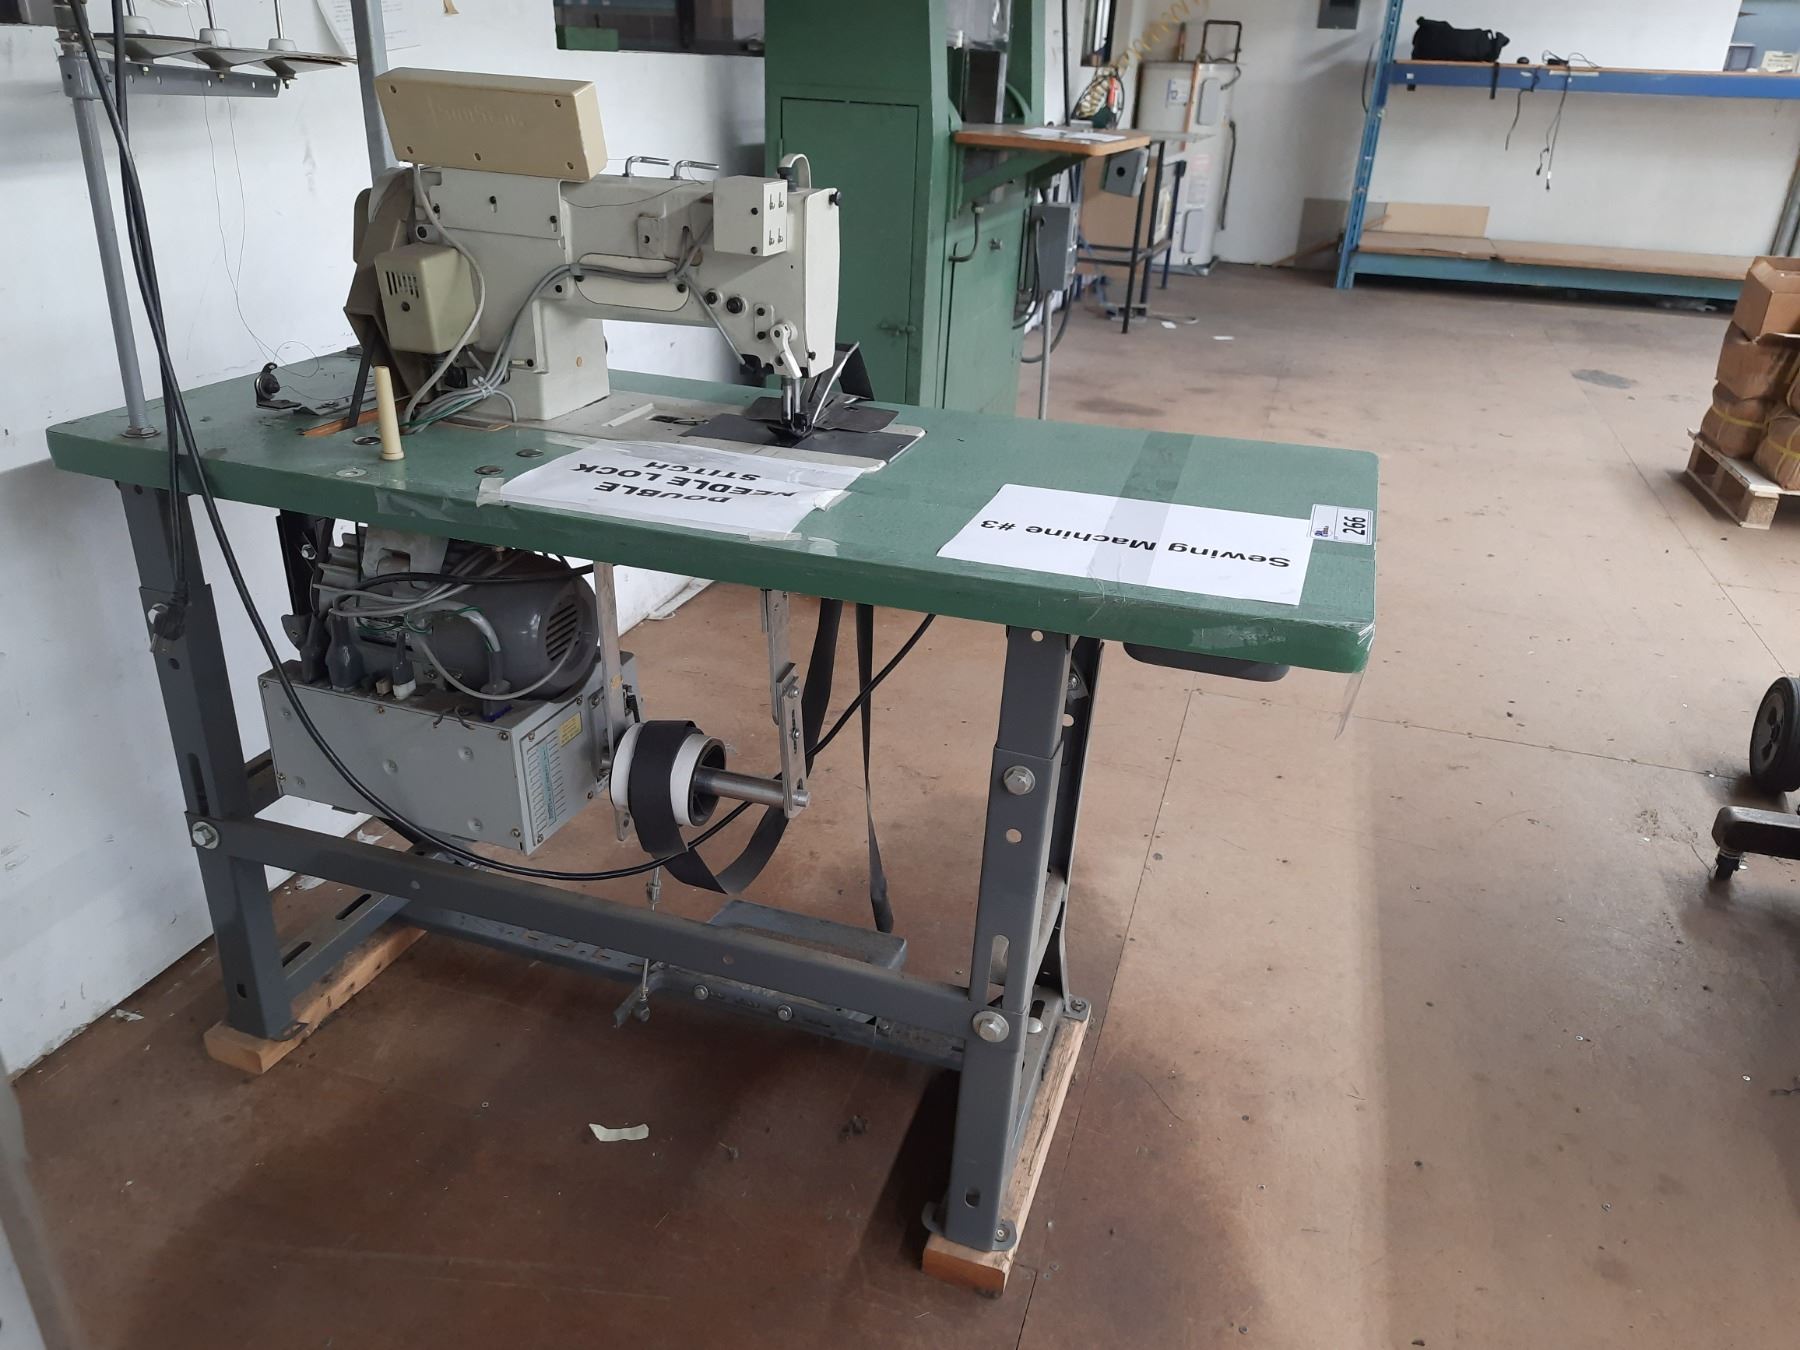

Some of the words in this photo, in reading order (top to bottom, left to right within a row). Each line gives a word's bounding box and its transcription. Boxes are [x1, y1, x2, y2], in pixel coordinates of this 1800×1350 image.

[572, 463, 662, 481] LOCK
[645, 461, 760, 481] STITCH
[594, 481, 732, 503] DOUBLE
[666, 476, 798, 497] NEEDLE
[980, 520, 1016, 531] #3
[1342, 516, 1366, 536] 266
[1026, 525, 1156, 551] Machine
[1168, 542, 1291, 568] Sewing
